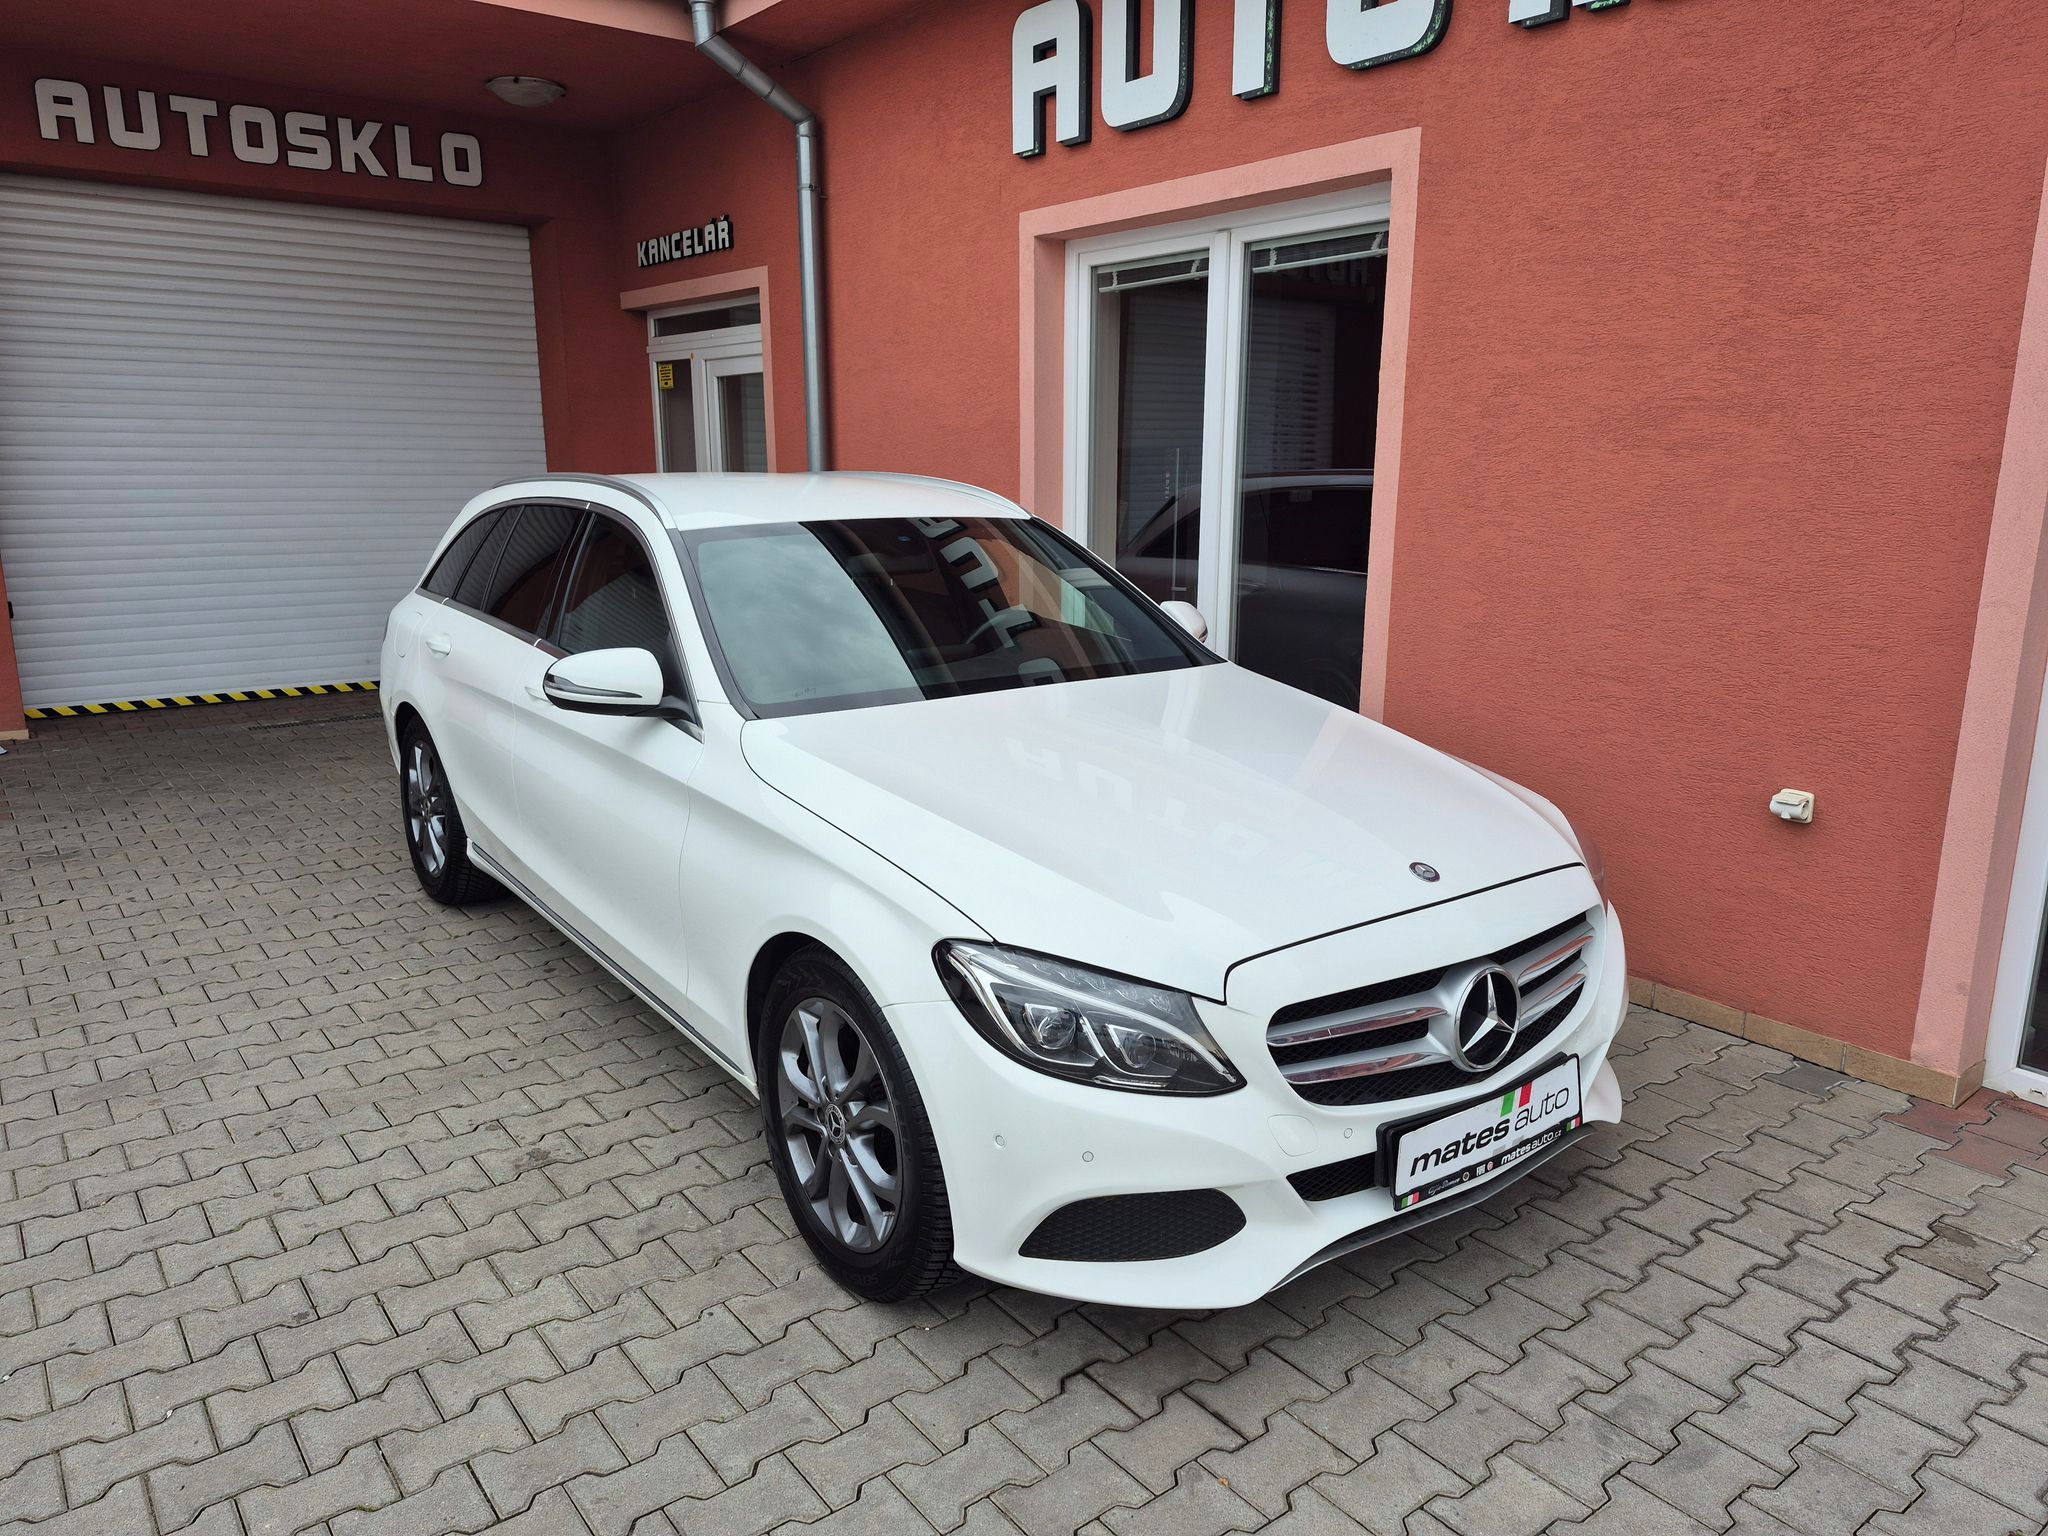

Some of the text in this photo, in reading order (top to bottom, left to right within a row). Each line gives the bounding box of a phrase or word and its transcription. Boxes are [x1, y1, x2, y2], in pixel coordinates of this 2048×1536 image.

[34, 77, 484, 188] AUTOSKLO
[637, 214, 733, 268] KANCELÁŘ
[1410, 1087, 1570, 1177] mates auto
